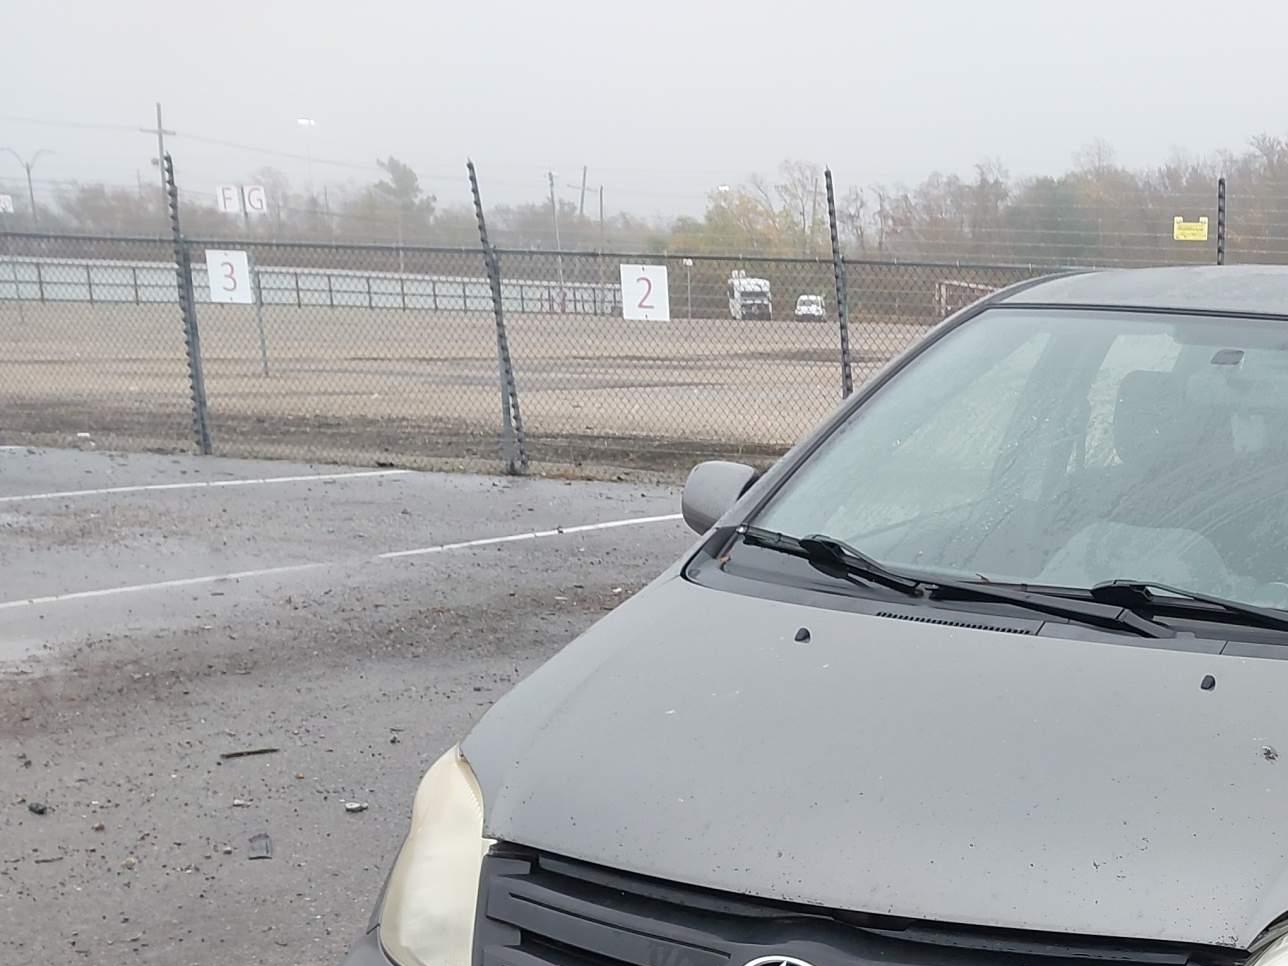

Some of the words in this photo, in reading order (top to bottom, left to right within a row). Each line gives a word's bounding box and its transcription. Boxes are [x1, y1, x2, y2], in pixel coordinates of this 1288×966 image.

[222, 187, 233, 209] F
[248, 187, 263, 210] G
[221, 262, 237, 292] 3
[636, 276, 655, 309] 2
